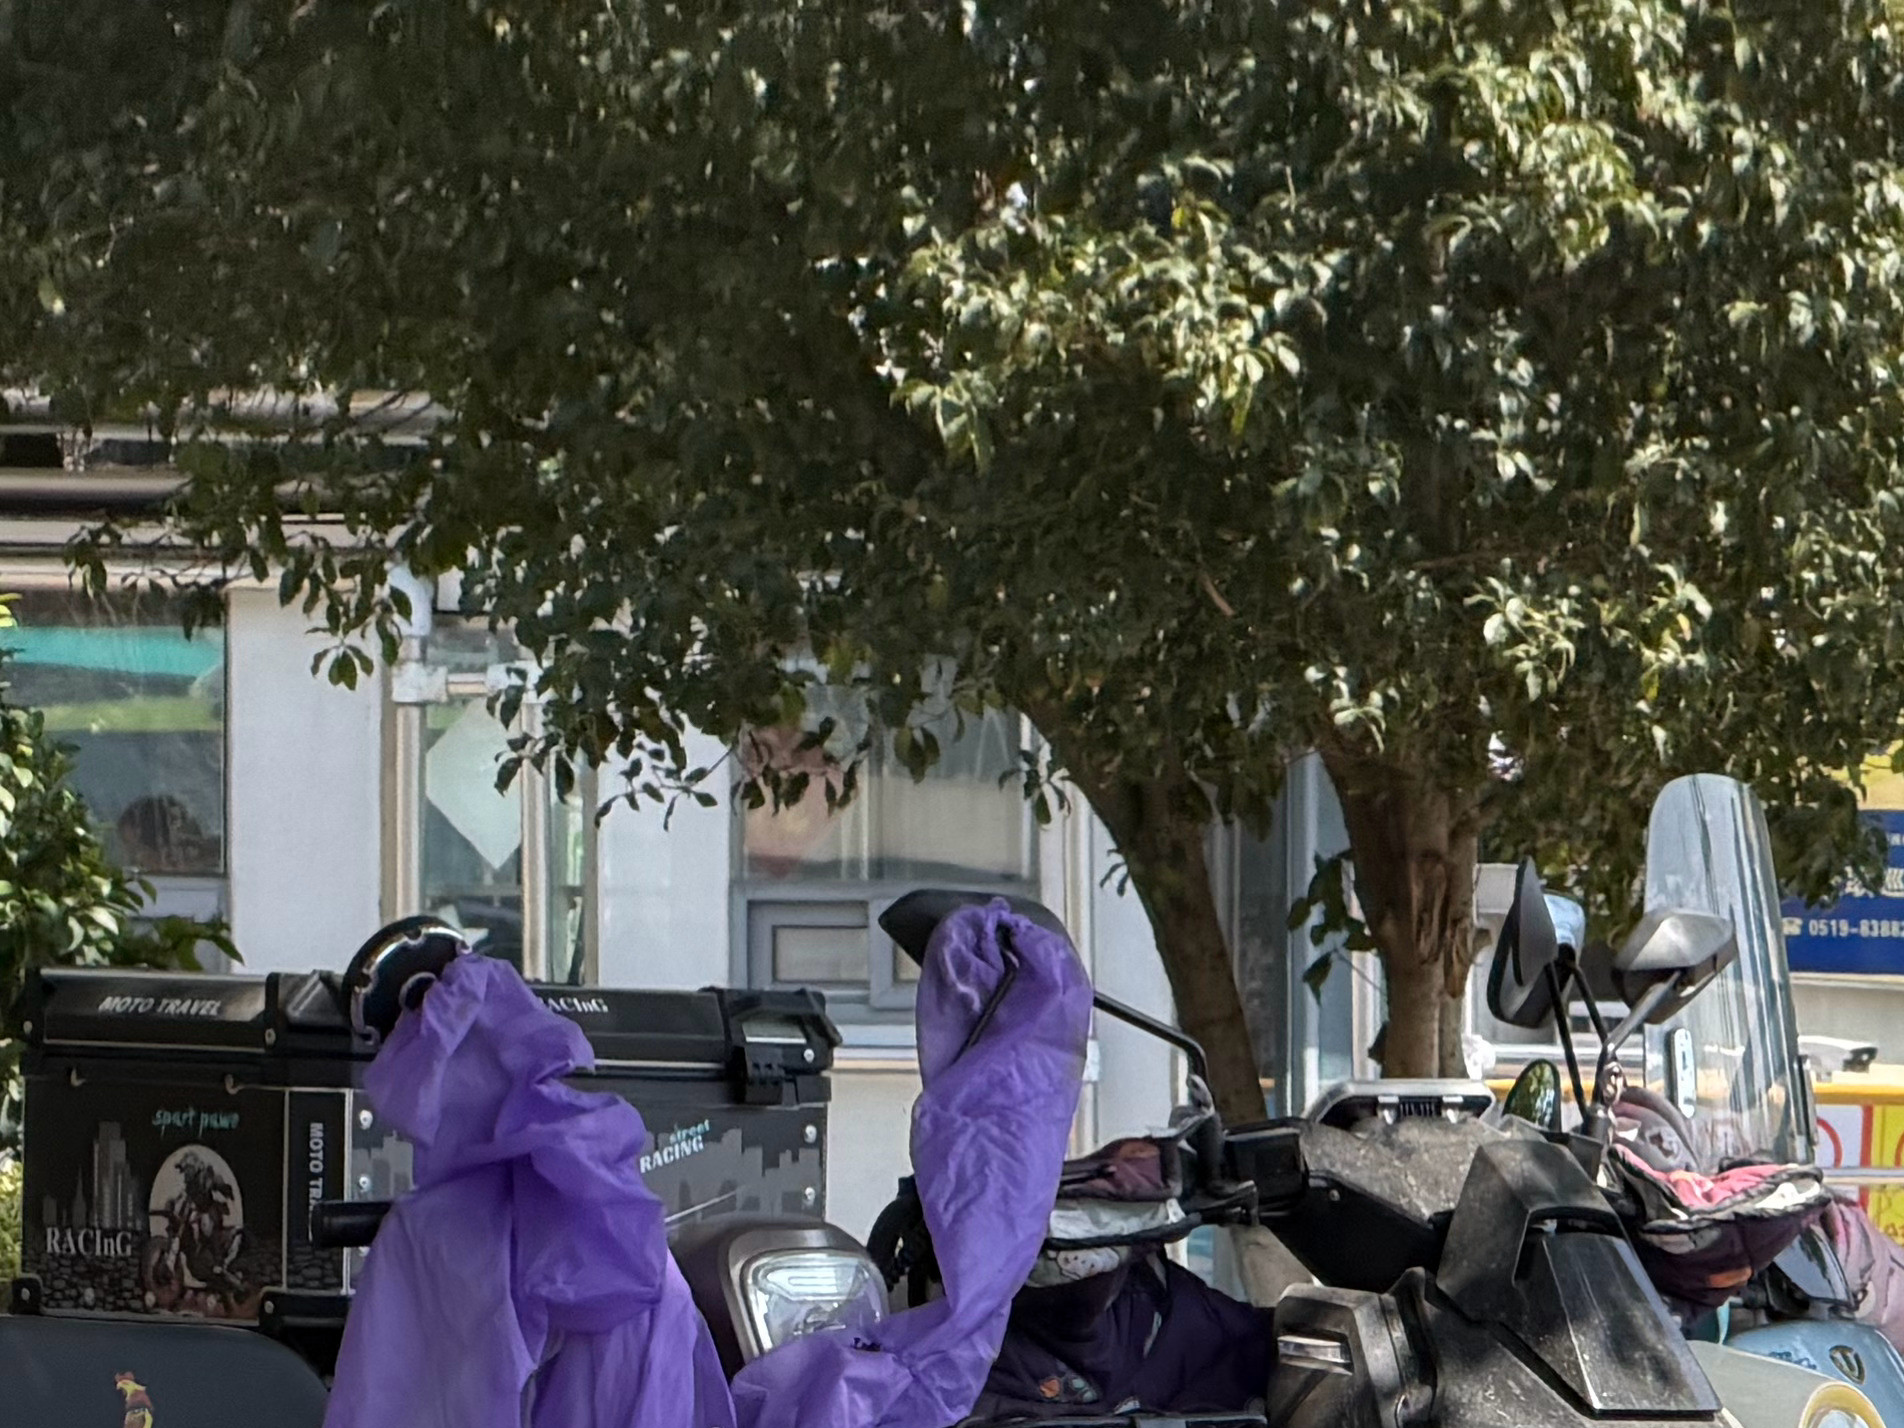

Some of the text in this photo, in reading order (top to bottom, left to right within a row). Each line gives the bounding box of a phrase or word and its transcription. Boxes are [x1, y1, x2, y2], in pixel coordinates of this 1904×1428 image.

[99, 996, 222, 1017] MOTO TRAVEL
[309, 1122, 324, 1173] MOTO
[639, 1136, 705, 1174] RACING
